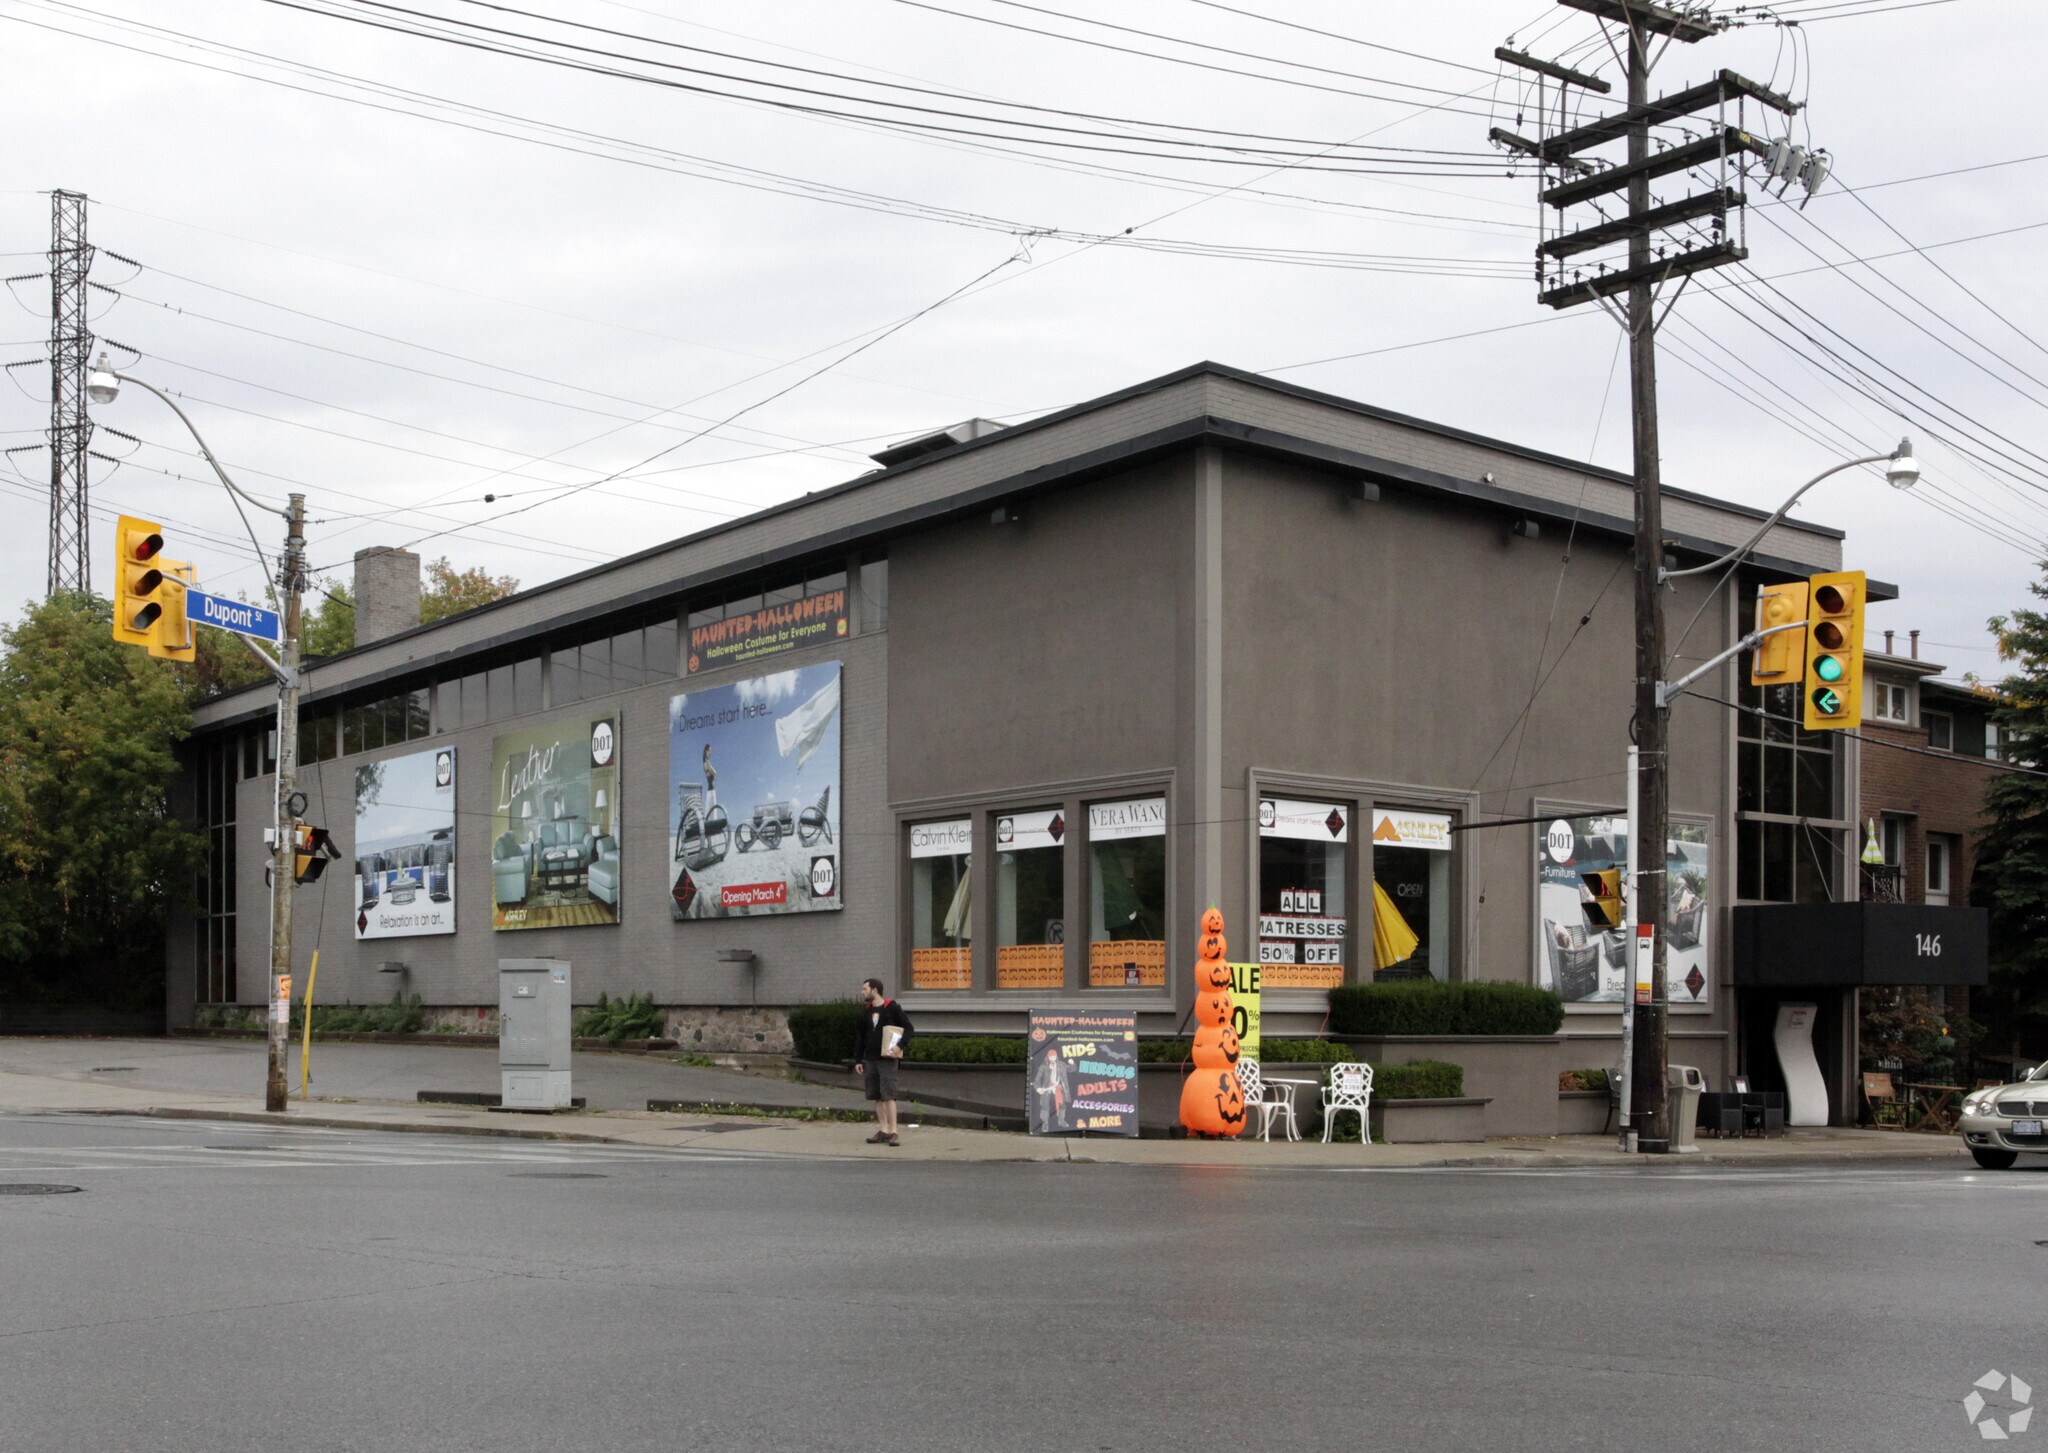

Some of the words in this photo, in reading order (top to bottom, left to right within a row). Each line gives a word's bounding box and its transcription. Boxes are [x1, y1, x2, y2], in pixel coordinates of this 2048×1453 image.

[205, 596, 252, 628] Dupont
[255, 610, 262, 622] St
[692, 590, 844, 648] HAUNTED-HALLOWEEN
[707, 642, 743, 659] Halloween
[745, 634, 777, 650] Costume
[778, 629, 789, 643] for
[790, 622, 827, 639] Everyone
[679, 714, 715, 732] Dreams
[718, 705, 740, 725] start
[497, 741, 559, 811] Leather
[1091, 808, 1126, 826] VERA
[911, 826, 946, 847] Calvin
[1396, 819, 1447, 840] ASHLEY
[1544, 866, 1576, 878] Furniture
[722, 890, 752, 904] Opening
[752, 887, 774, 900] March
[1397, 883, 1423, 896] OPEN
[1283, 896, 1318, 909] ALL
[380, 914, 413, 928] Relaxation
[421, 915, 430, 926] an
[1915, 933, 1941, 956] 146
[1261, 947, 1293, 960] 50%
[1306, 948, 1338, 960] OFF
[1227, 967, 1260, 993] ALE
[1031, 1016, 1134, 1027] HAUNTED-HALLOWEEN
[1062, 1043, 1096, 1058] KIDS
[1079, 1060, 1135, 1079] HEROES
[1077, 1079, 1128, 1096] ADULTS
[1072, 1100, 1135, 1113] ACCESSORIES
[1076, 1118, 1087, 1129] &
[1089, 1115, 1122, 1128] MORE
